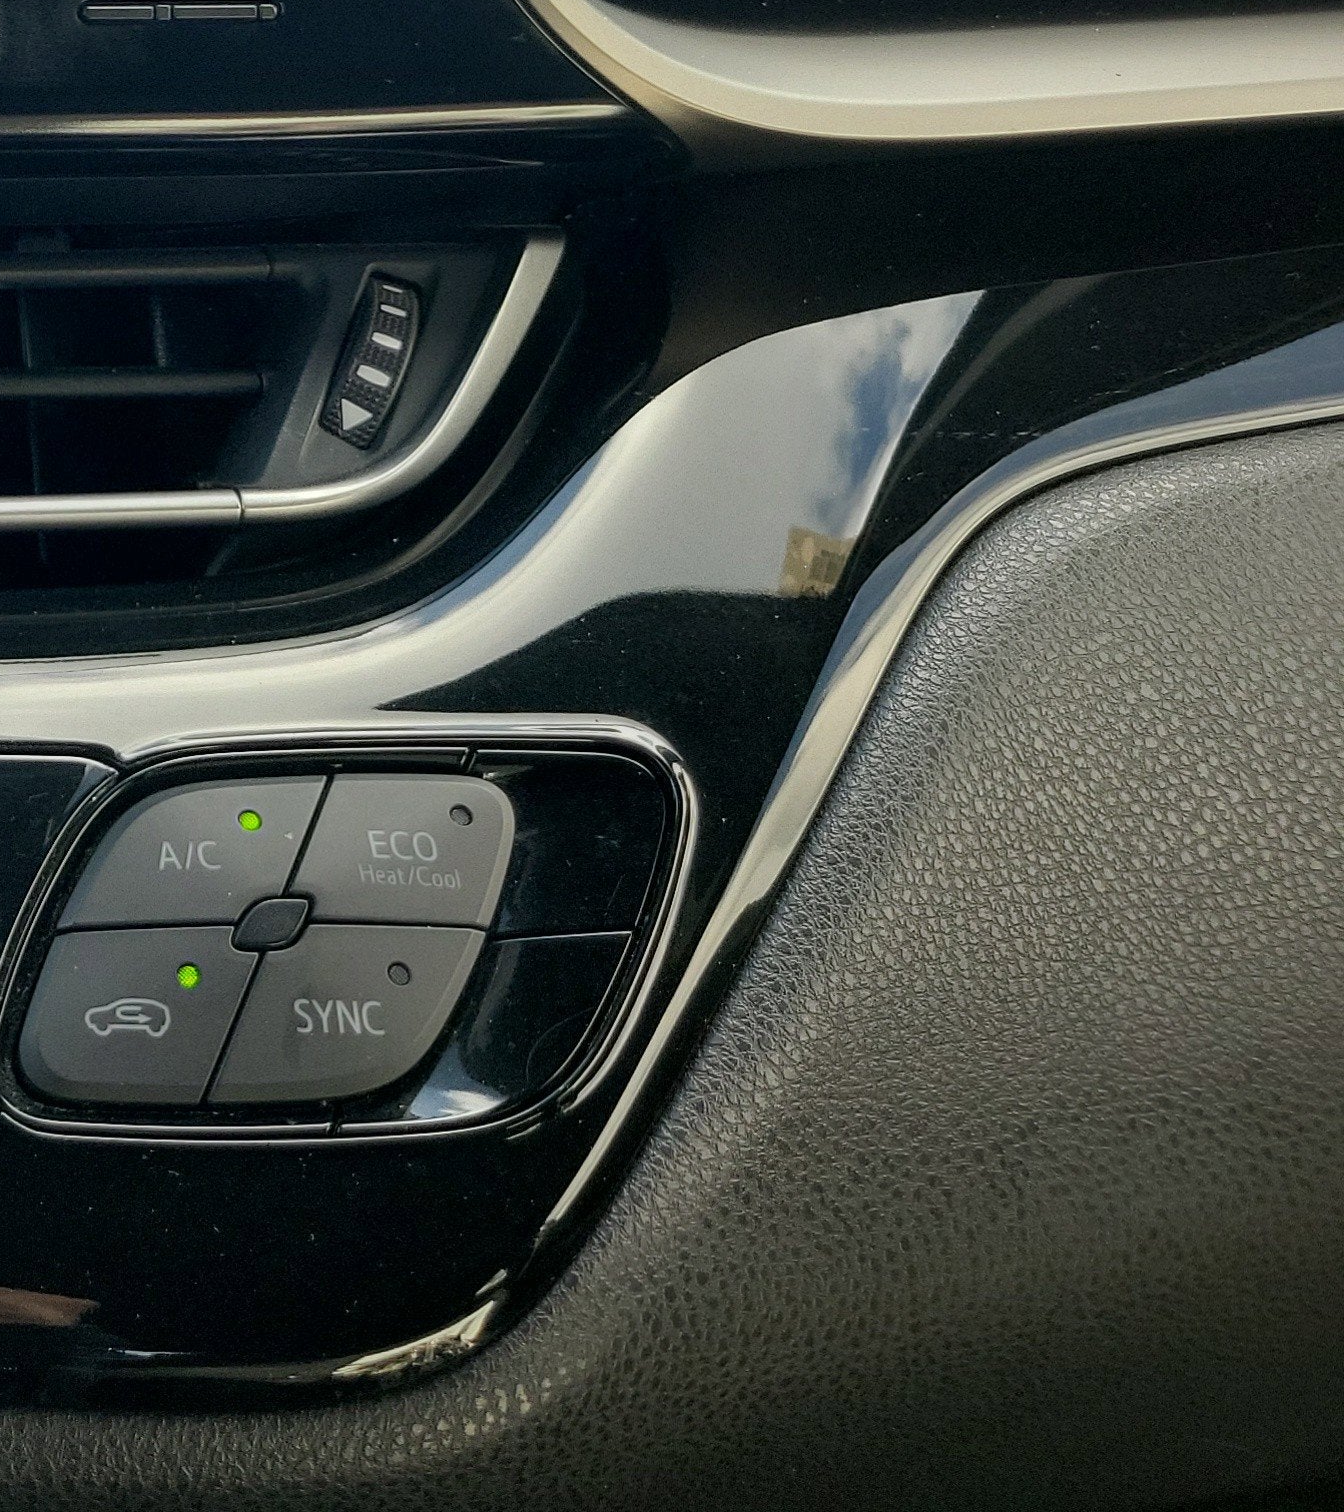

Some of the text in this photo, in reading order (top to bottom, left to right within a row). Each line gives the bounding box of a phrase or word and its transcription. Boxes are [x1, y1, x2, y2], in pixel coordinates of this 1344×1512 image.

[157, 841, 222, 871] A/C
[367, 830, 439, 862] ECO
[357, 863, 462, 890] Heat/Cool
[292, 999, 386, 1037] SYNC
